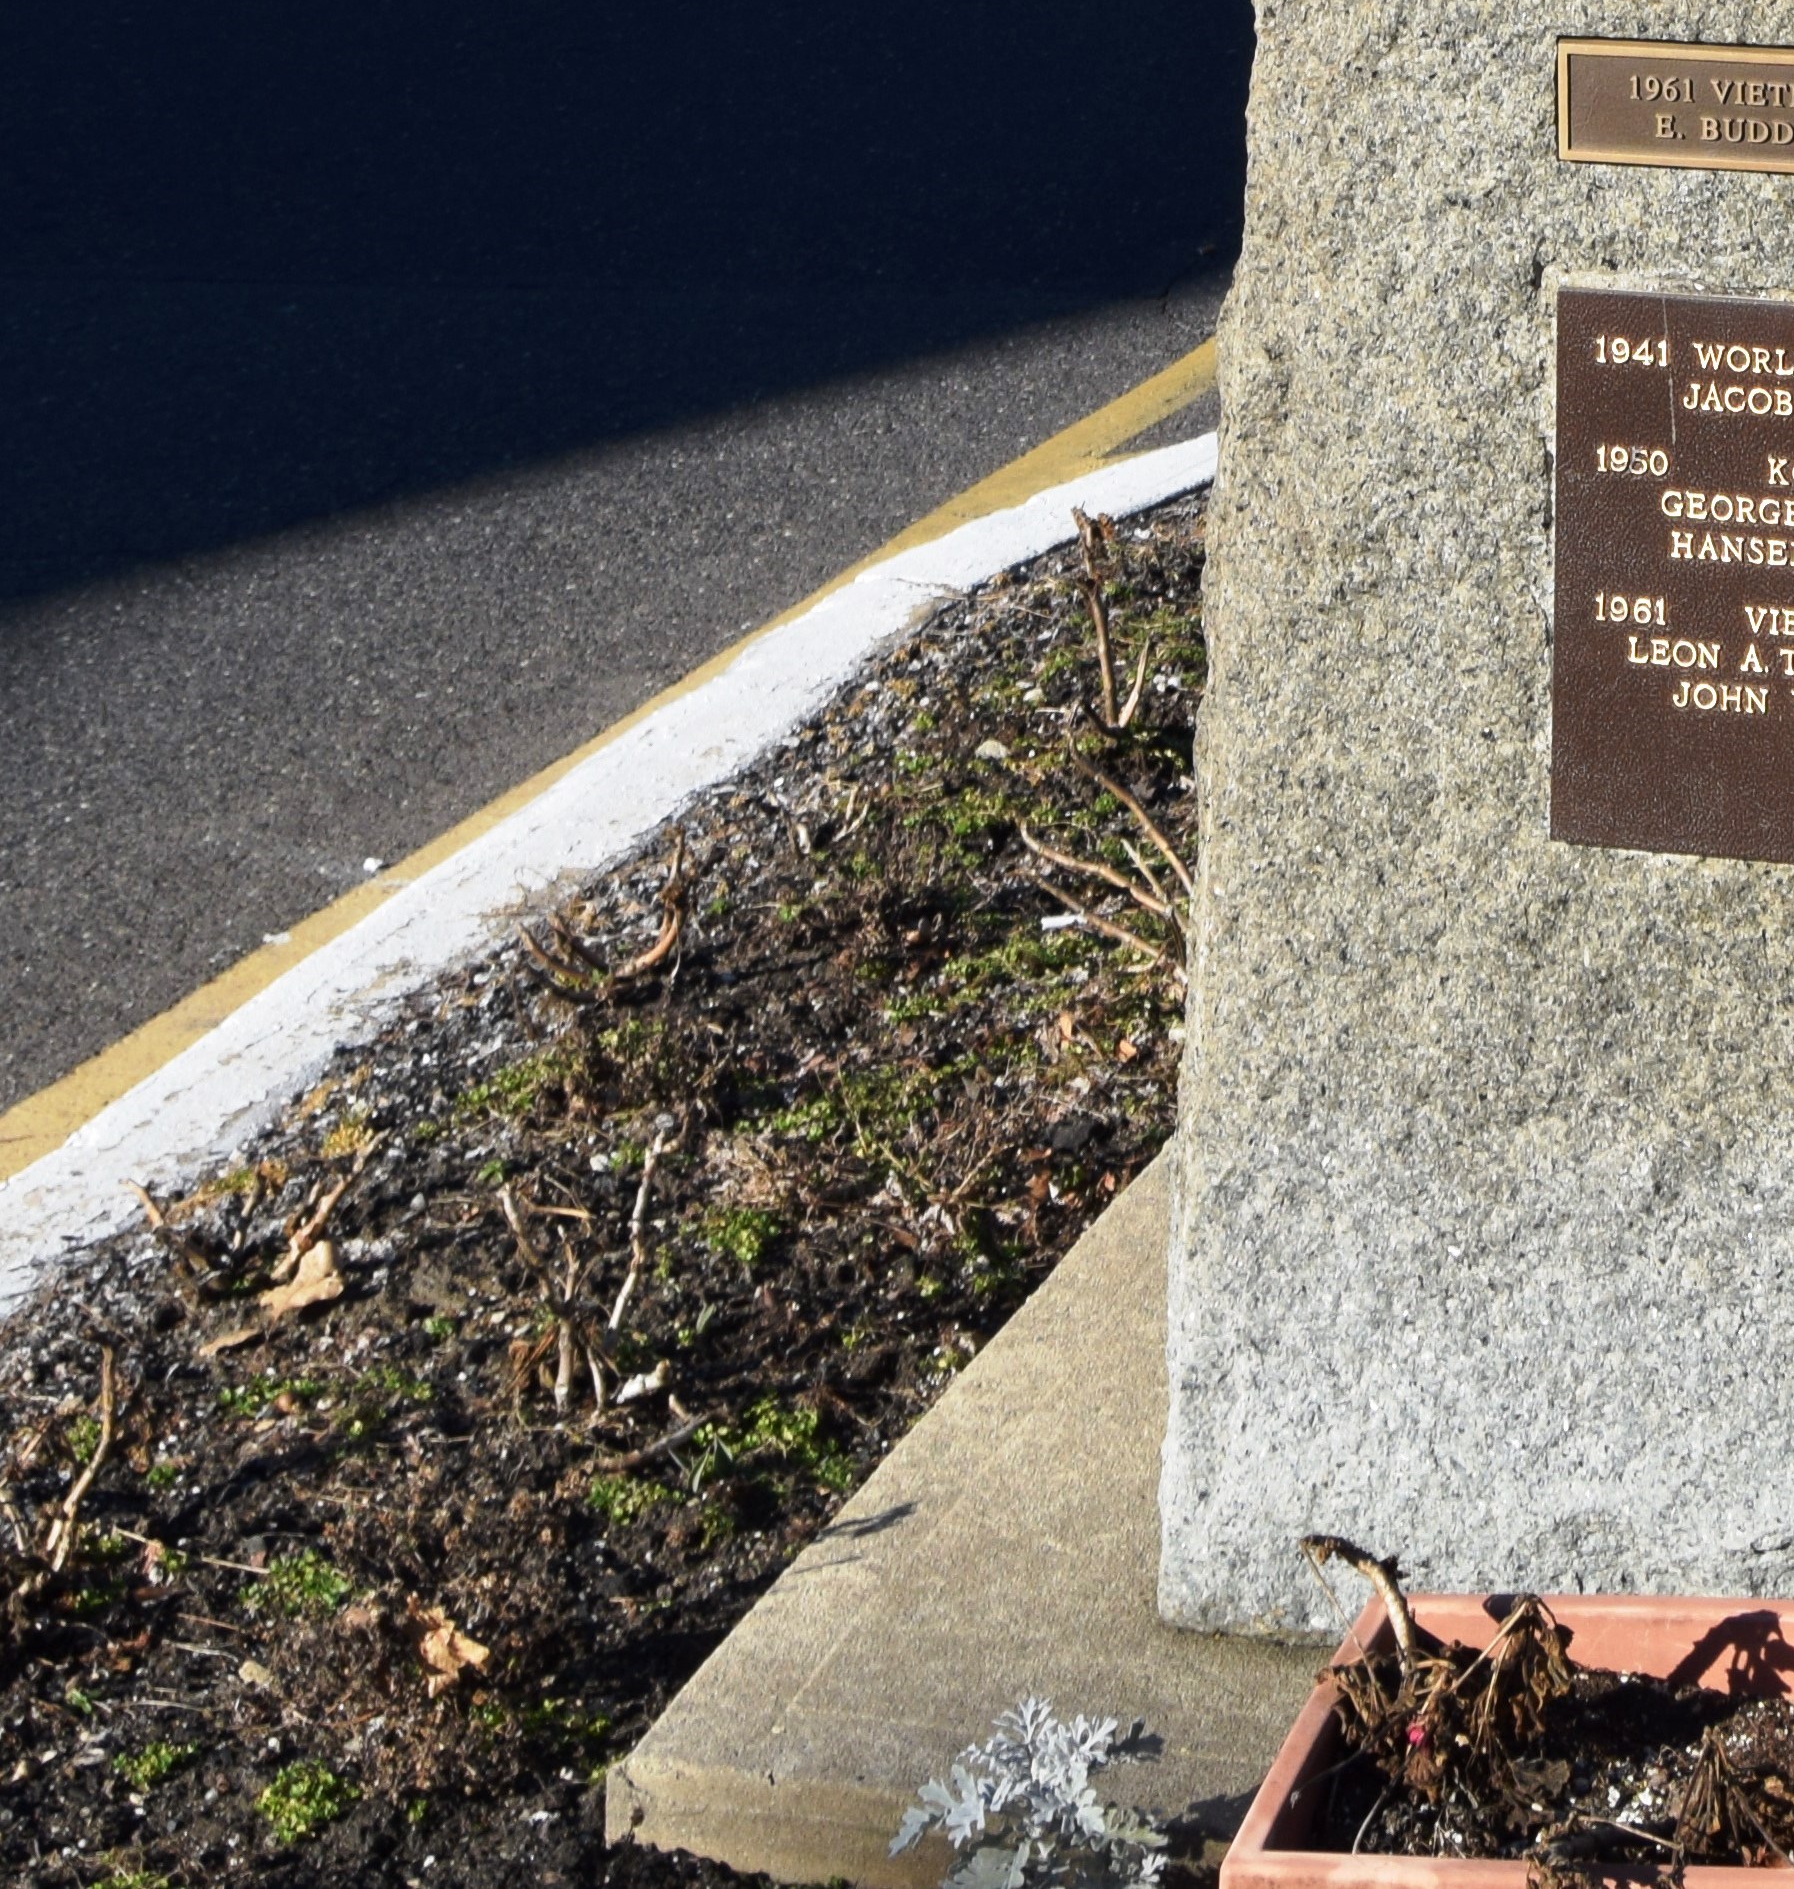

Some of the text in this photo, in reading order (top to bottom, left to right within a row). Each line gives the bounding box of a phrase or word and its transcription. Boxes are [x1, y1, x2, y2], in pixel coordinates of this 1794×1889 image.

[1629, 74, 1695, 103] 1961
[1655, 114, 1684, 139] E.
[1595, 337, 1669, 367] 1941
[1683, 383, 1793, 416] JACOB
[1596, 445, 1668, 476] 1950
[1594, 592, 1667, 625] 1961
[1628, 637, 1721, 668] LEON
[1741, 649, 1769, 674] A.
[1673, 682, 1769, 714] JOHN
